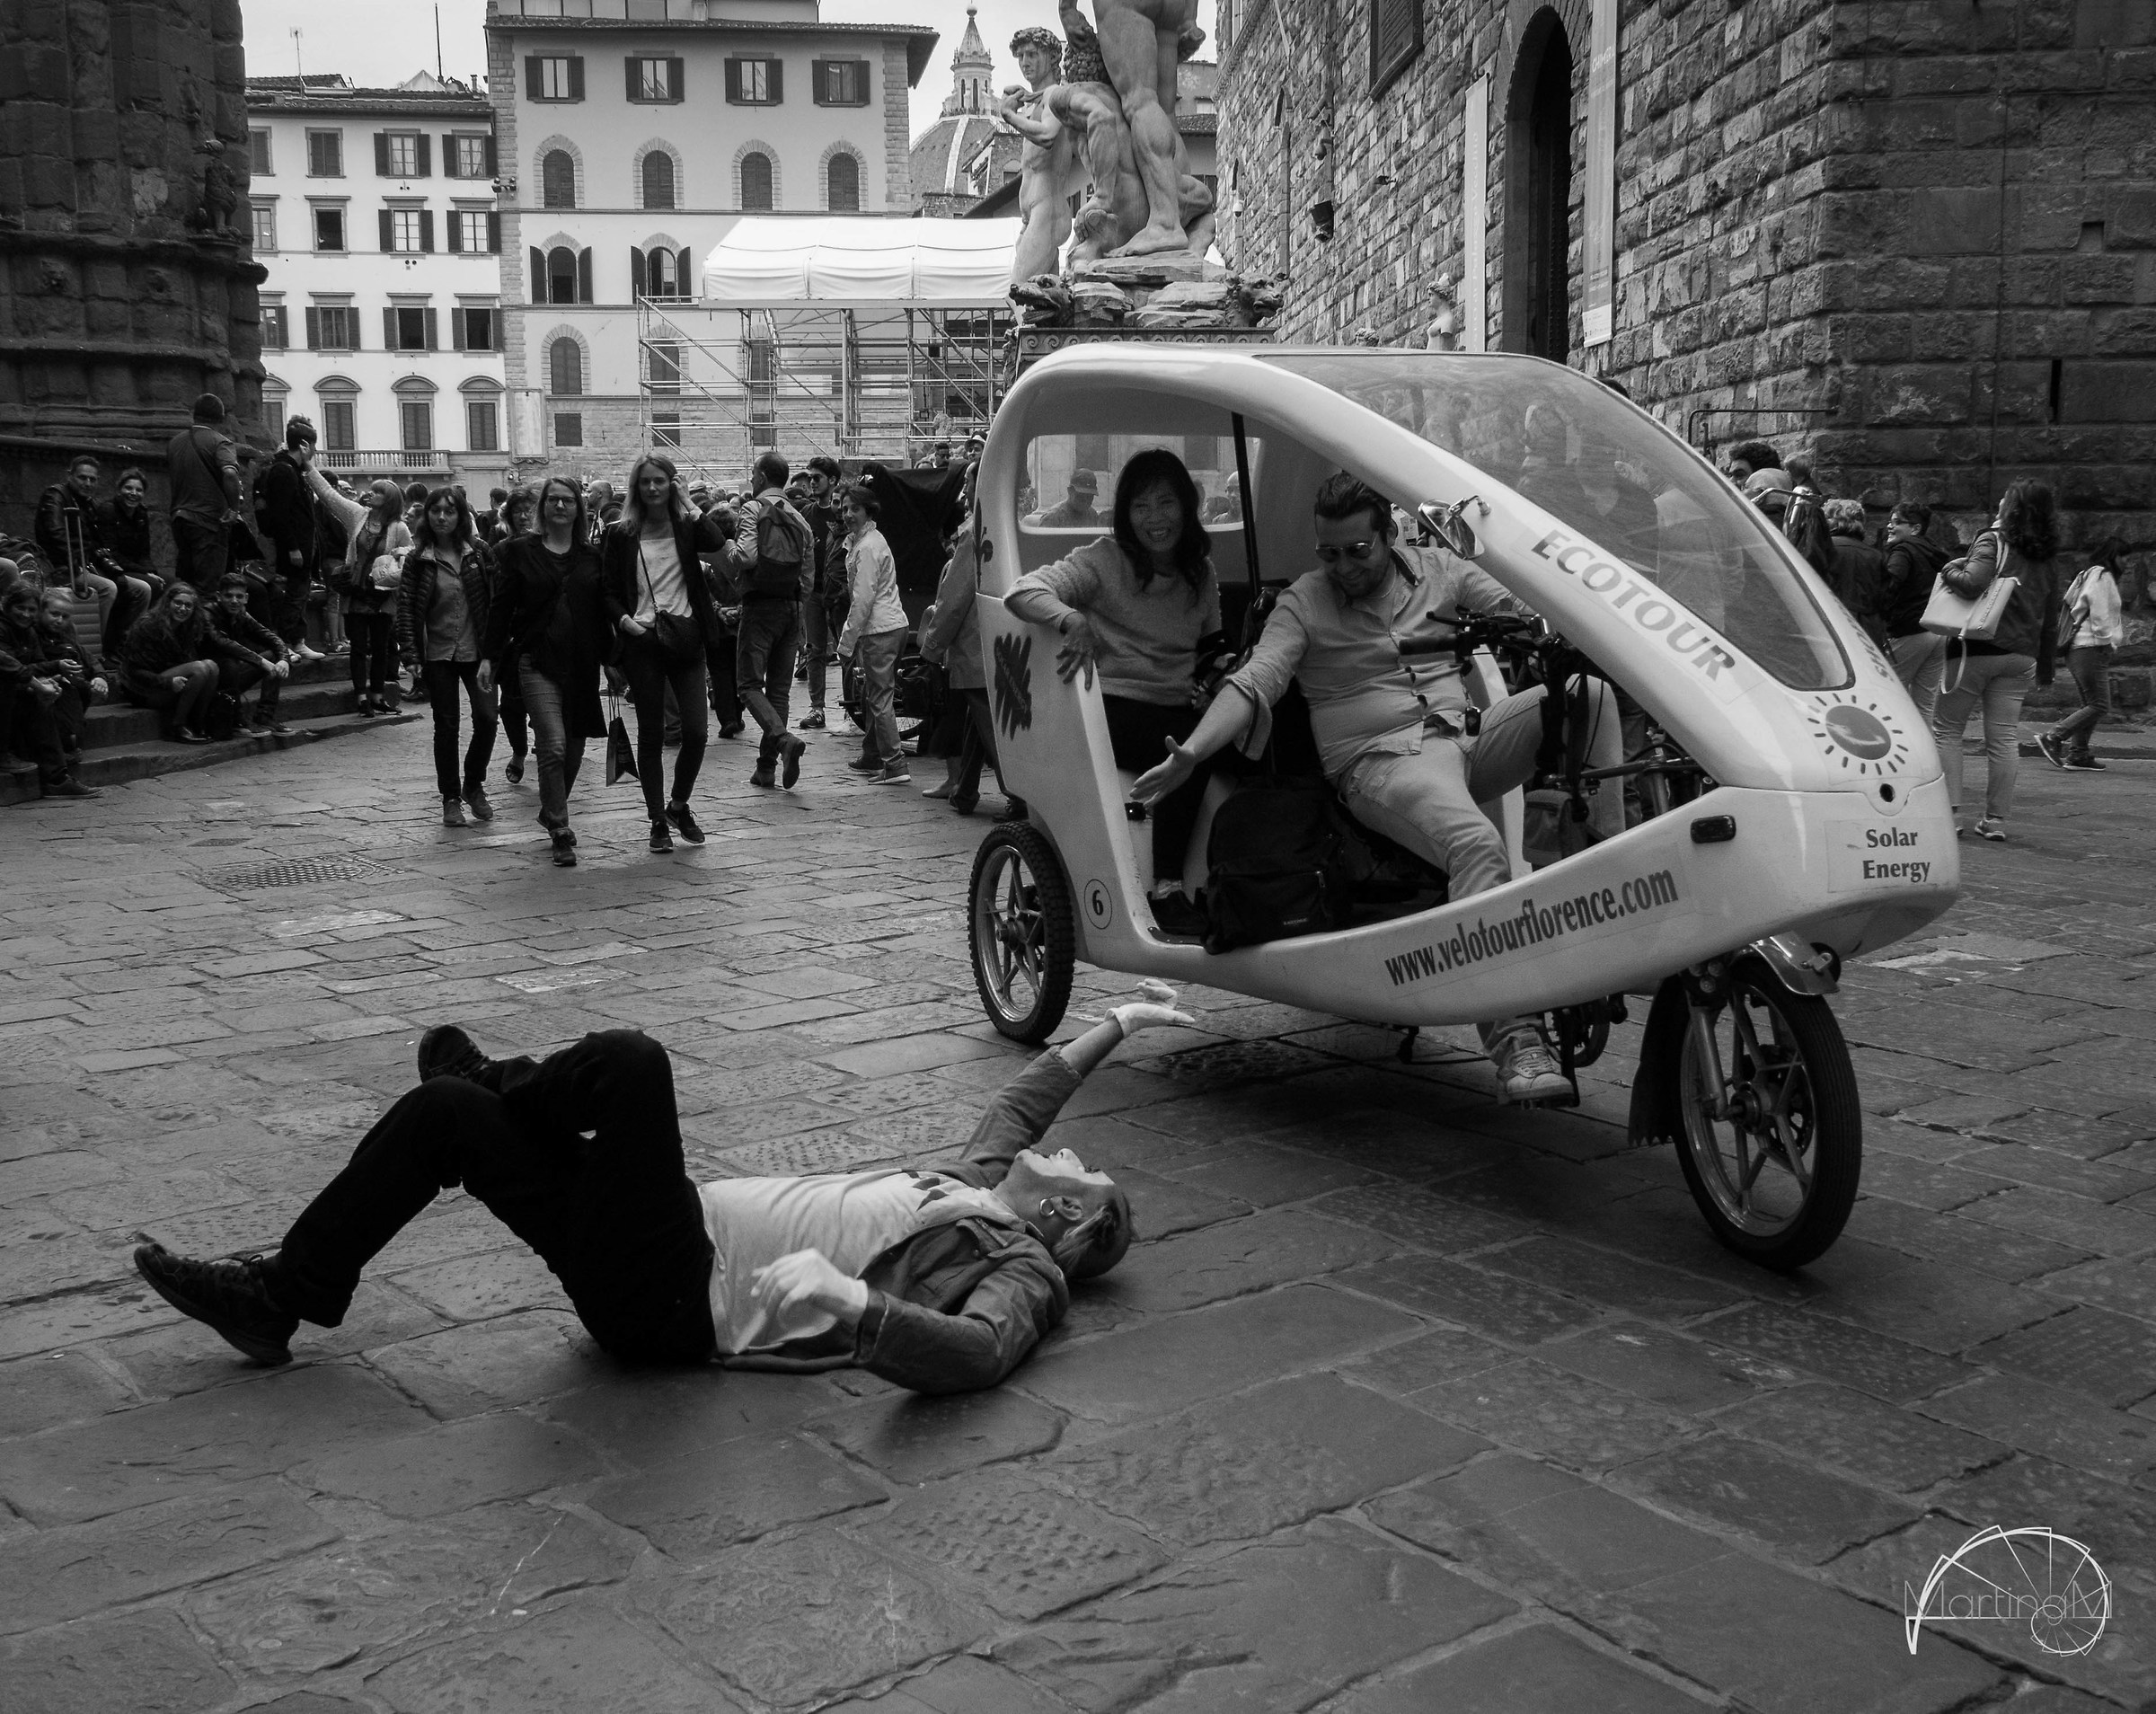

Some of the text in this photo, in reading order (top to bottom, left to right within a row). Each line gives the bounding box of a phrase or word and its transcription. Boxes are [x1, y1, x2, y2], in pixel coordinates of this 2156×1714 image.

[1531, 528, 1736, 681] ECOTOUR
[1866, 826, 1918, 848] Solar
[1862, 860, 1931, 883] Energy
[1091, 889, 1104, 915] 6
[1384, 869, 1679, 986] www.velotourflorence.com
